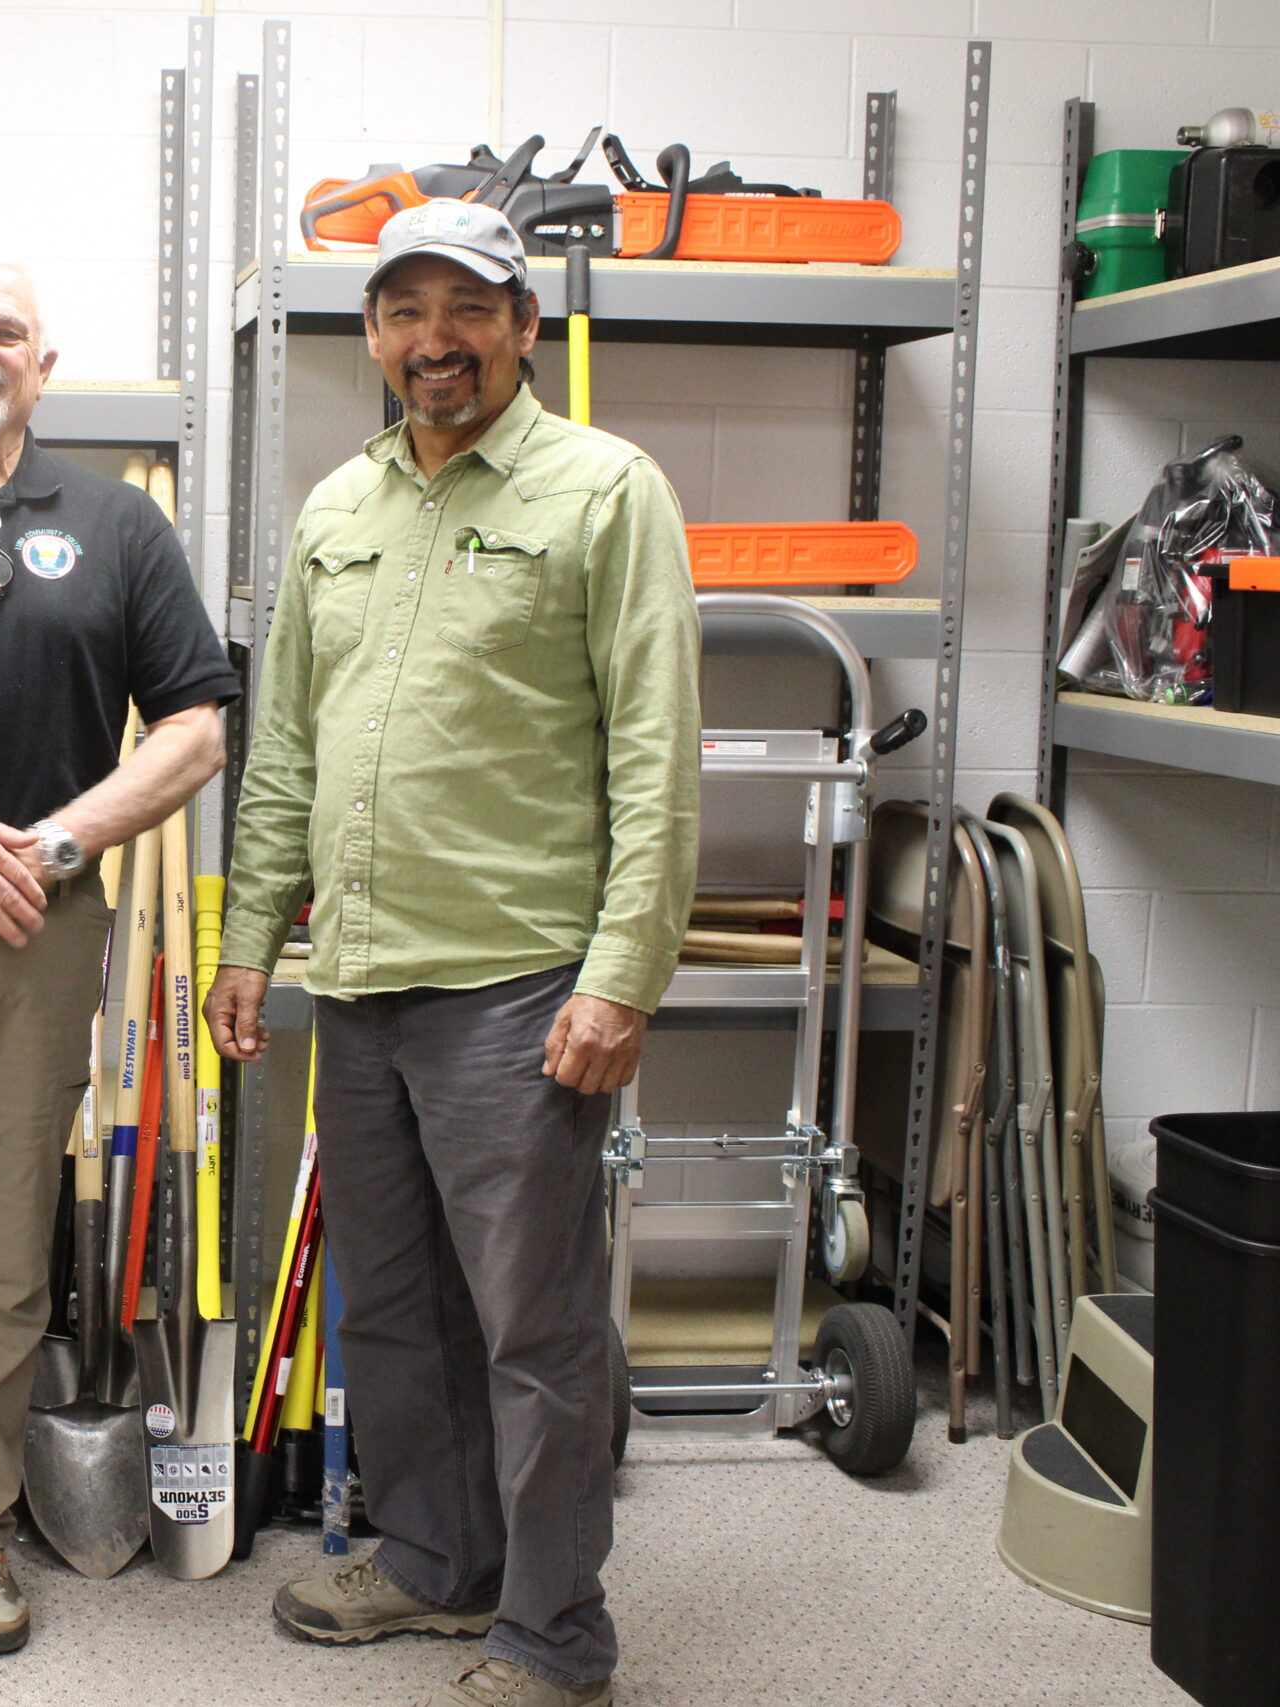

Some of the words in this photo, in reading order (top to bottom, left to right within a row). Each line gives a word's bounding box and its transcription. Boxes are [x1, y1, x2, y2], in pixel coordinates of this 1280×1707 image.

[540, 224, 569, 235] ECHO
[25, 528, 64, 539] COMMUNITY
[64, 534, 84, 556] COLLEGE
[176, 891, 185, 914] WRTC
[137, 908, 146, 932] WRTC
[175, 974, 190, 1049] SEYMOUR
[122, 1019, 138, 1089] WESTWARD
[207, 1155, 216, 1176] WRTC
[160, 1490, 226, 1503] SEYMOUR
